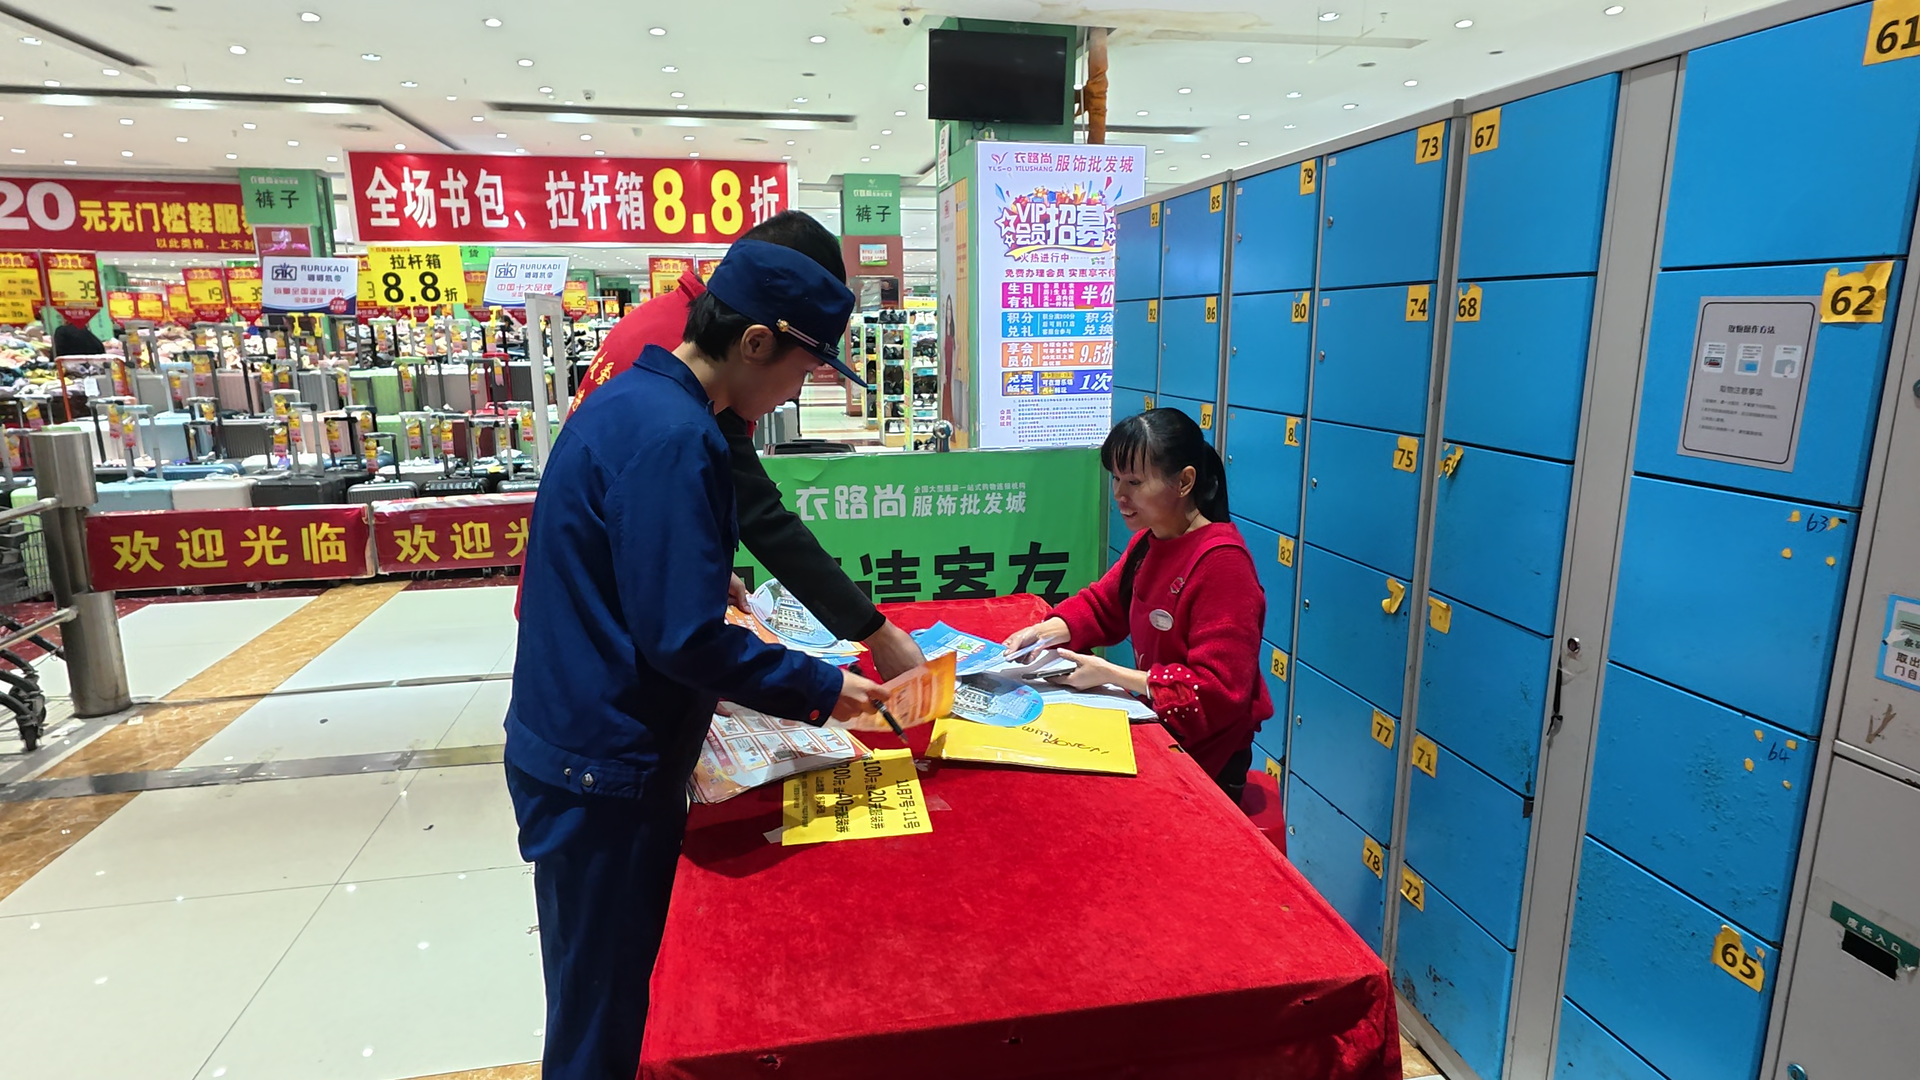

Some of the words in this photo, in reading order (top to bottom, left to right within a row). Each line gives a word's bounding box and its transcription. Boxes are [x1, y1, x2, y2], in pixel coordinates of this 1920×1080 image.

[1876, 17, 1920, 55] 61
[1475, 124, 1496, 148] 67
[1421, 137, 1440, 159] 73
[1014, 152, 1053, 164] 衣路尚
[1055, 155, 1135, 173] 服饰批发城
[1303, 167, 1315, 185] 79
[255, 189, 300, 210] 裤子
[1211, 195, 1221, 210] 85
[856, 204, 892, 223] 裤子
[1016, 202, 1046, 223] VIP
[1151, 212, 1159, 225] 91
[1015, 223, 1046, 245] 会员
[1046, 203, 1106, 246] 招募
[390, 253, 441, 270] 拉杆箱
[1020, 252, 1070, 263] 火热进行中
[301, 265, 349, 273] RURUKADI
[1005, 268, 1065, 278] 免费办理会员
[78, 280, 97, 299] 39
[208, 286, 223, 302] 19
[382, 270, 458, 303] 8.8折
[497, 283, 553, 292] 中国十大品牌
[1007, 283, 1034, 295] 生日
[1081, 284, 1115, 305] 半价
[1007, 296, 1035, 308] 有礼
[1410, 298, 1428, 318] 74
[1457, 296, 1478, 318] 68
[1829, 285, 1876, 317] 62
[1007, 312, 1034, 324] 积分
[1085, 312, 1114, 323] 积分
[1149, 308, 1157, 321] 92
[1206, 306, 1216, 321] 86
[1294, 302, 1307, 320] 80
[1007, 326, 1034, 337] 兑礼
[1083, 325, 1113, 336] 兑换
[1007, 343, 1034, 355] 享会
[1007, 355, 1034, 367] 员价
[1080, 372, 1113, 391] 1次
[1202, 413, 1211, 427] 87
[1397, 448, 1414, 468] 75
[795, 483, 907, 521] 衣路尚
[912, 491, 1027, 518] 服饰批发城
[1806, 512, 1829, 533] 63
[110, 521, 348, 575] 欢迎光临
[1279, 546, 1292, 564] 82
[1273, 659, 1286, 677] 83
[1375, 720, 1392, 742] 77
[1416, 746, 1433, 772] 71
[1767, 741, 1791, 765] 64
[1365, 847, 1382, 873] 78
[1403, 880, 1422, 905] 72
[1720, 942, 1758, 981] 65
